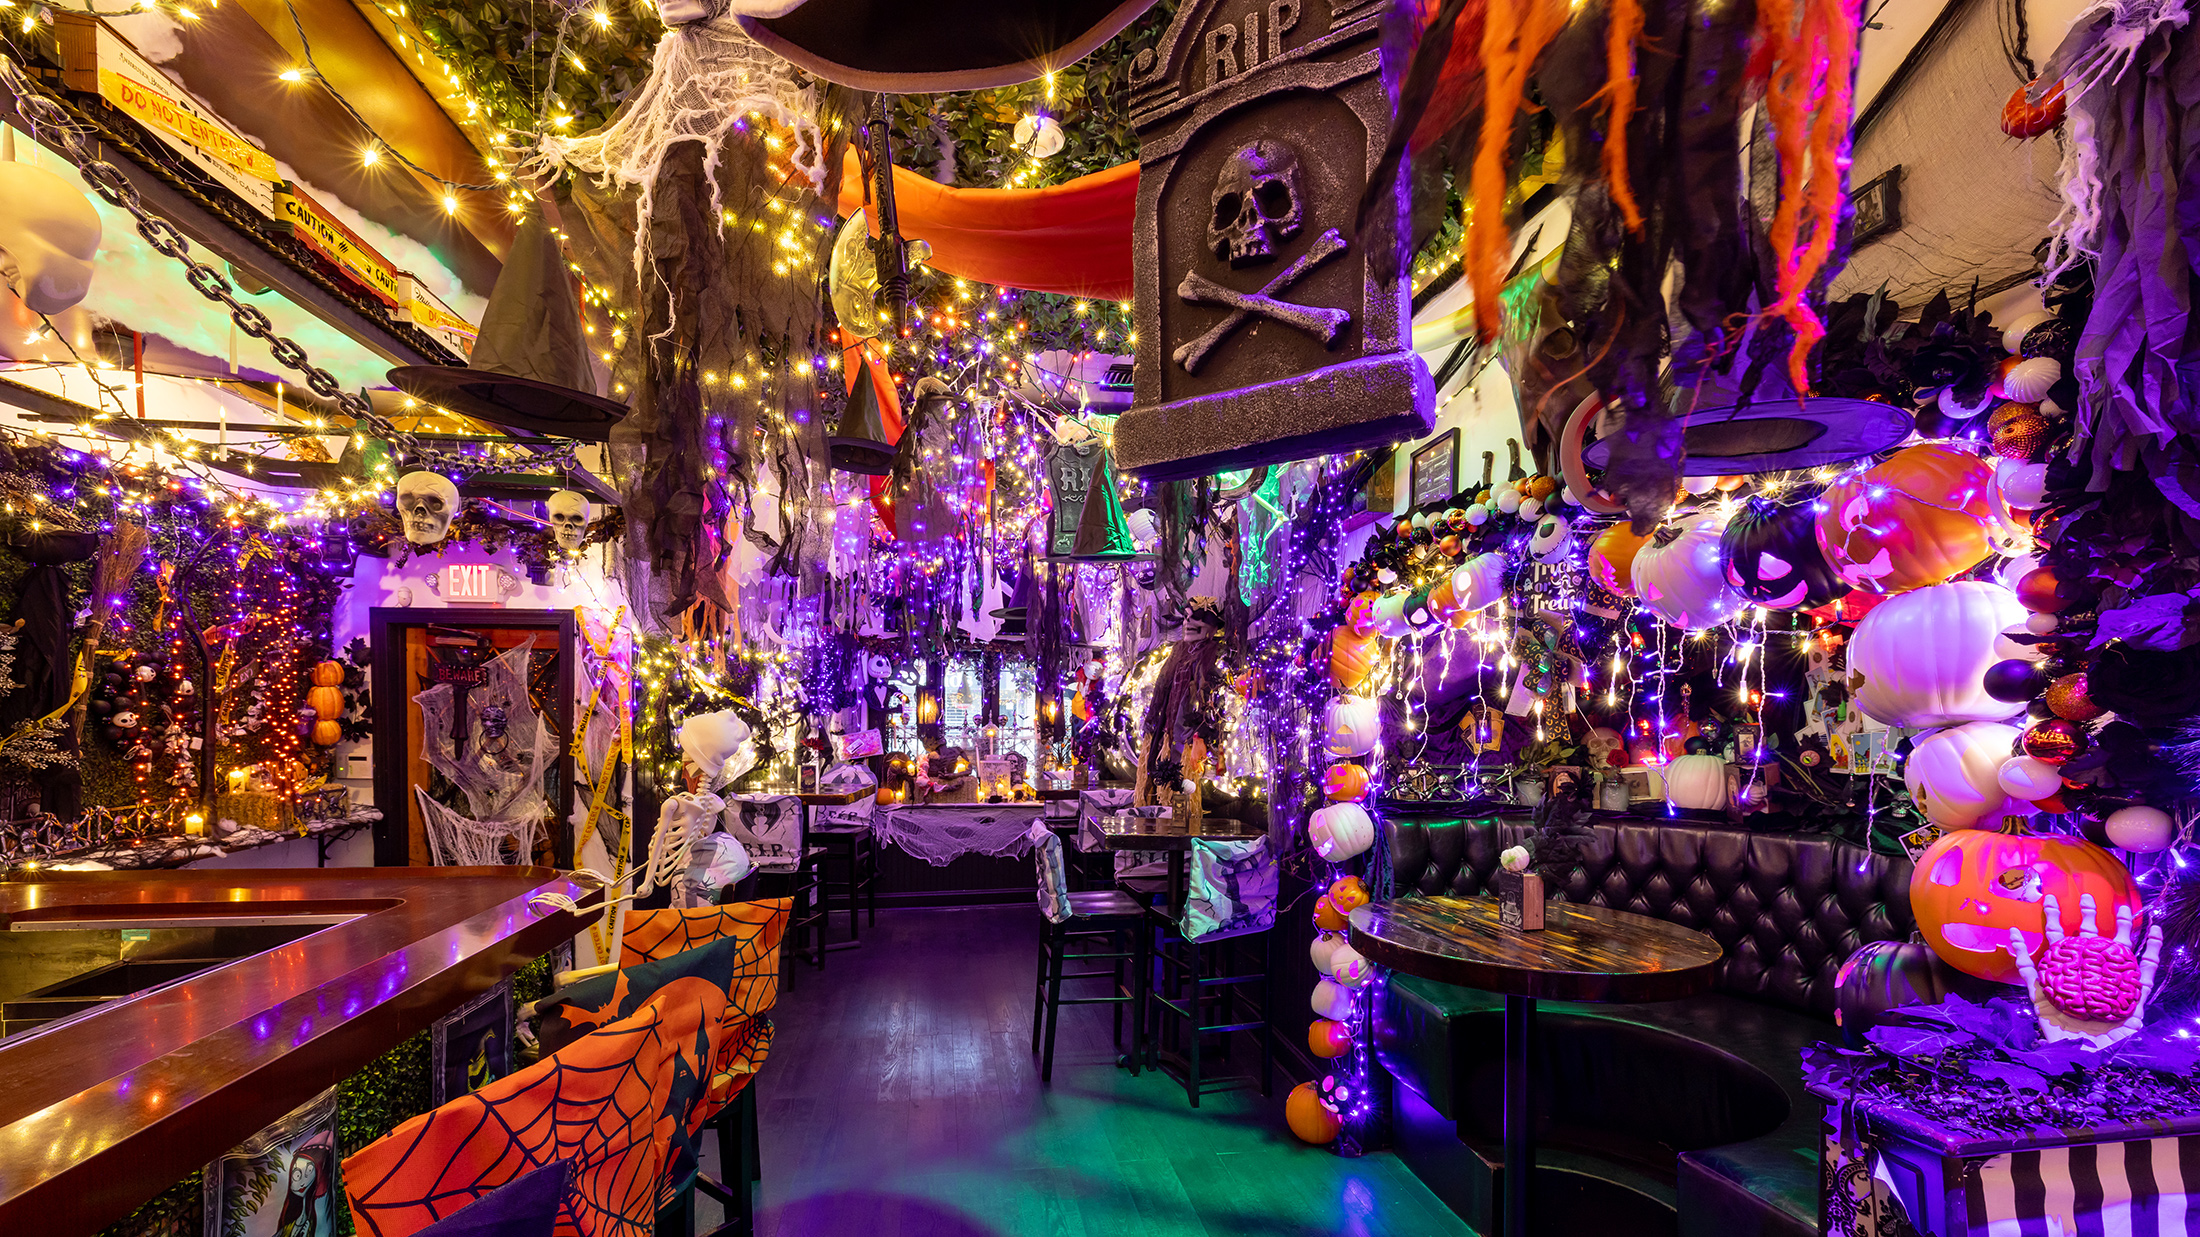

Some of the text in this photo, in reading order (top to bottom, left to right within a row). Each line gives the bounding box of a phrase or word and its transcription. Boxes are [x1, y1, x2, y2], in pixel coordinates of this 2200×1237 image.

[1206, 0, 1300, 88] RIP
[121, 84, 147, 111] DO
[151, 99, 184, 129] NOT
[240, 179, 258, 197] CAR
[285, 201, 334, 244] CAUTION
[376, 268, 398, 295] CAUTI
[1061, 467, 1091, 492] RI
[448, 564, 490, 597] EXIT
[438, 667, 481, 682] BEWARE
[597, 784, 606, 794] DO
[601, 771, 609, 784] NOT
[616, 854, 625, 880] CAUTION
[608, 905, 616, 930] CAUTION
